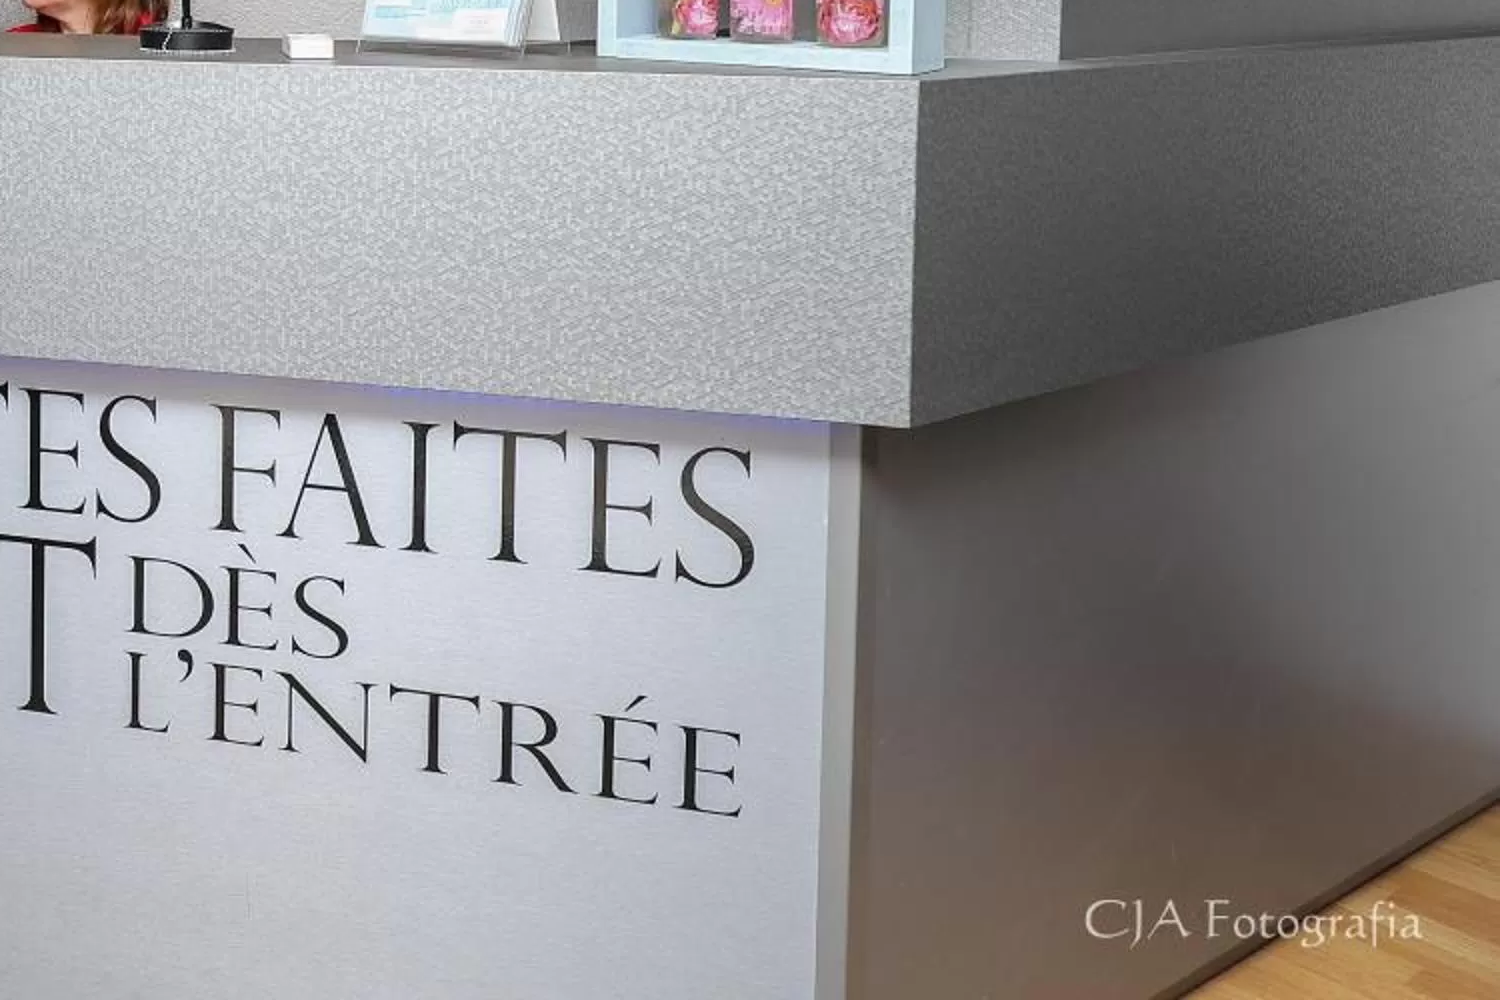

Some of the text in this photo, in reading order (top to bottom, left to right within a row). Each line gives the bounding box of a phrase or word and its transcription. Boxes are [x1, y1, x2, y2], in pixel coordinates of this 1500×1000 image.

[210, 403, 755, 588] FAITES
[125, 542, 349, 659] DÈS
[123, 648, 742, 818] L'ENTRÉE
